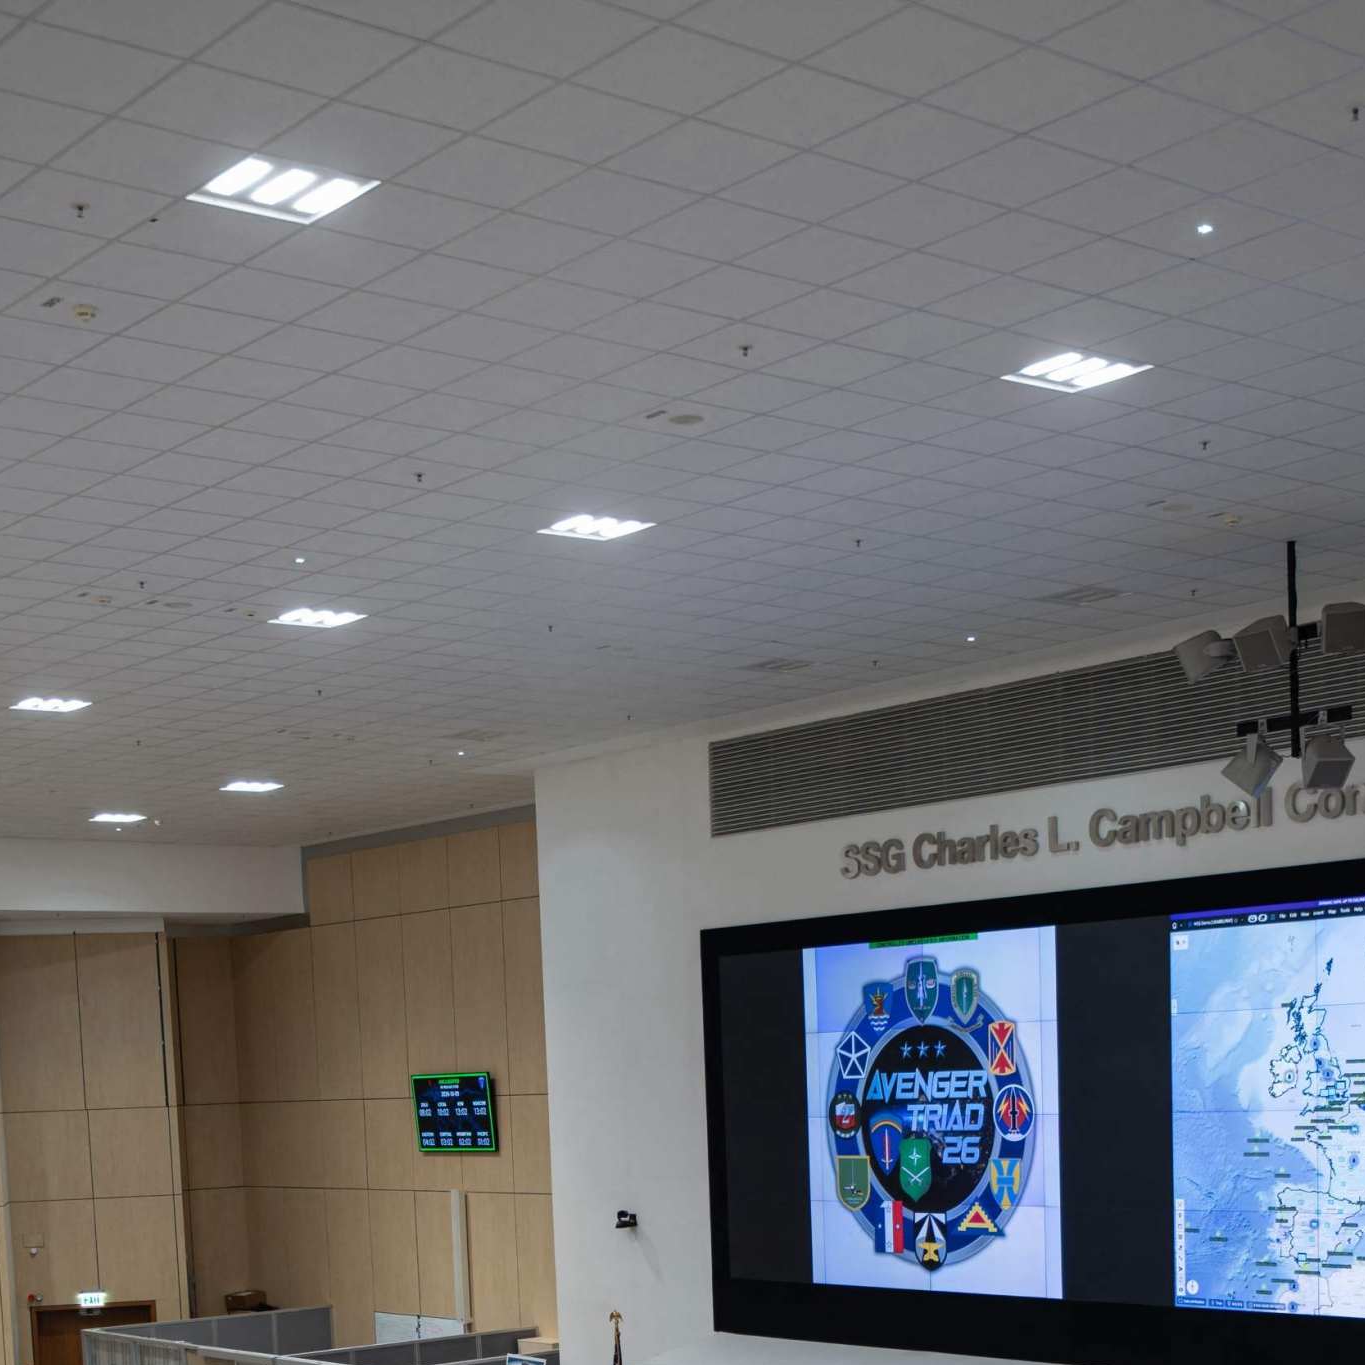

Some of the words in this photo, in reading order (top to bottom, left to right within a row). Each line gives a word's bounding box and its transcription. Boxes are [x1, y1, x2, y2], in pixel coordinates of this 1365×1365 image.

[840, 837, 907, 880] SSG
[913, 824, 1040, 870] Charles
[1047, 815, 1081, 854] L.
[1089, 785, 1274, 848] Campbell
[865, 1067, 988, 1104] AVENGER
[906, 1099, 985, 1133] TRIAD
[942, 1135, 982, 1165] 26
